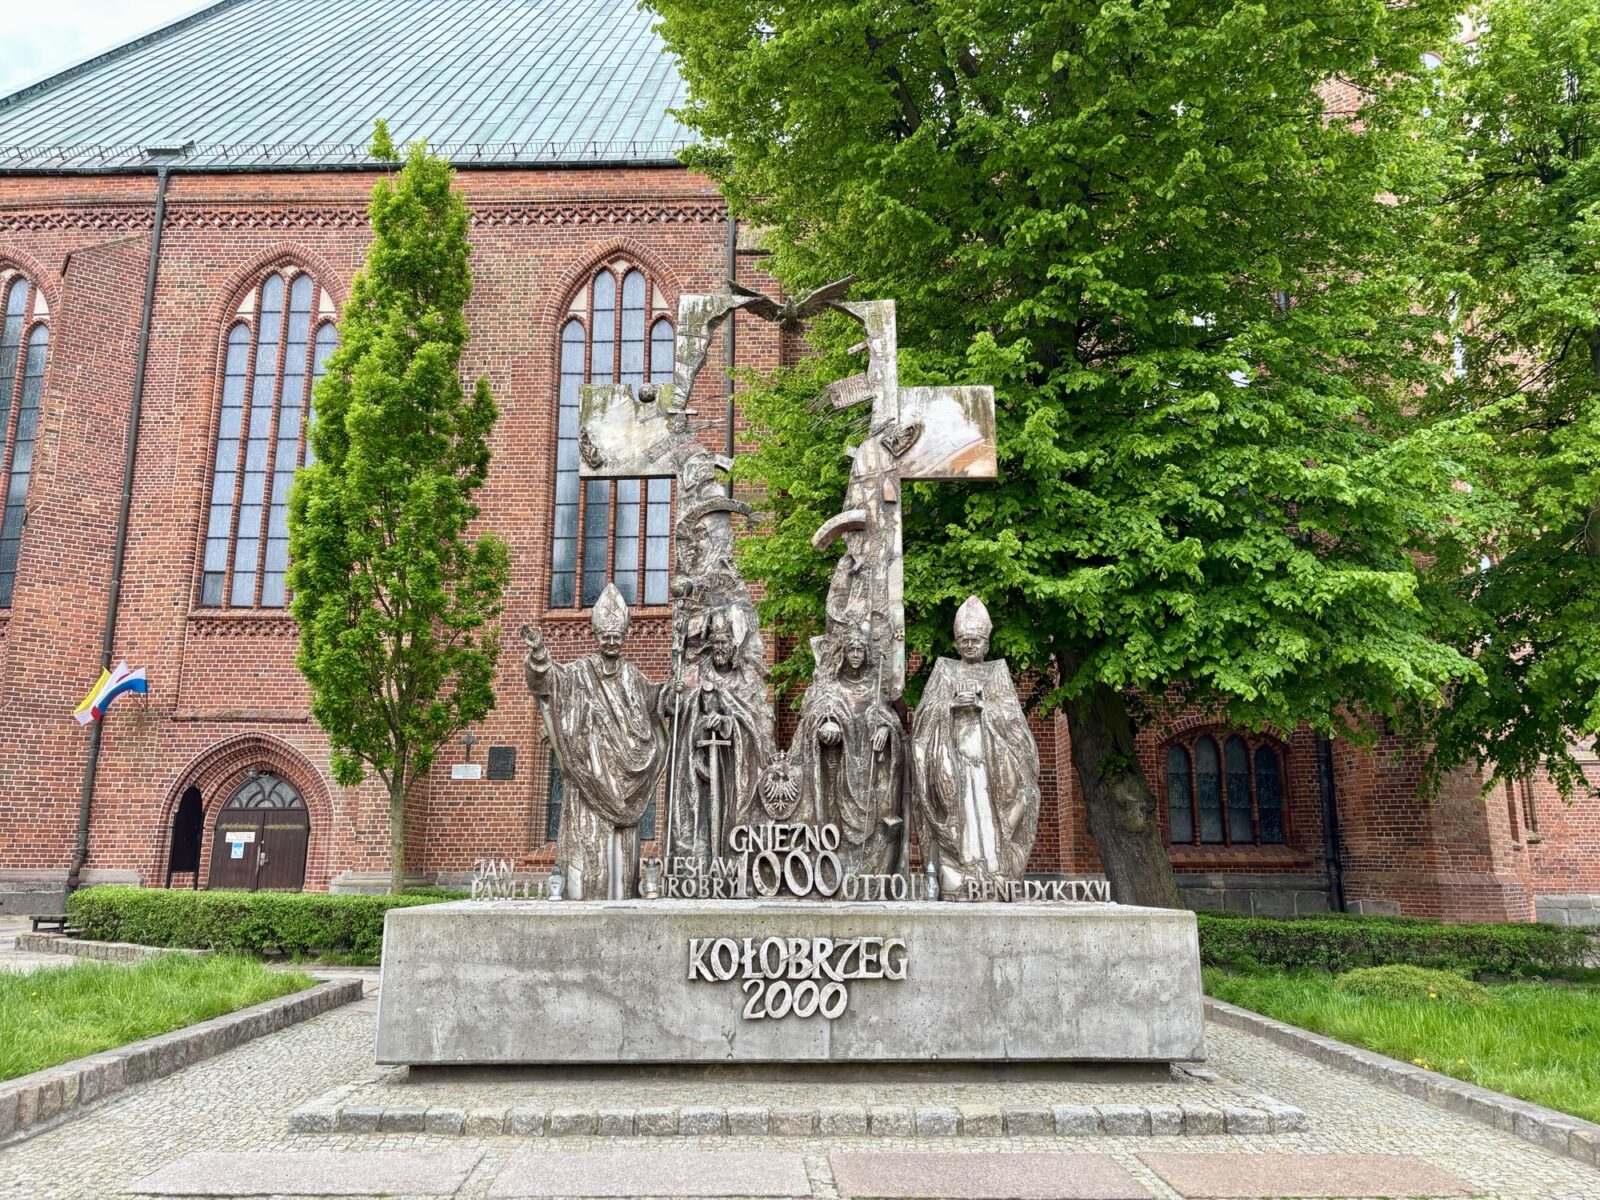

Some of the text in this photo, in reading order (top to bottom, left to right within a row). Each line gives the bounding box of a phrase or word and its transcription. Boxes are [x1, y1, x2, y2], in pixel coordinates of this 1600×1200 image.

[729, 820, 840, 852] GNIEZNO
[474, 858, 516, 881] JAN
[736, 849, 843, 898] 1000
[842, 873, 908, 901] OTTO
[687, 936, 909, 982] KOŁOBRZEG
[742, 979, 848, 1020] 2000
